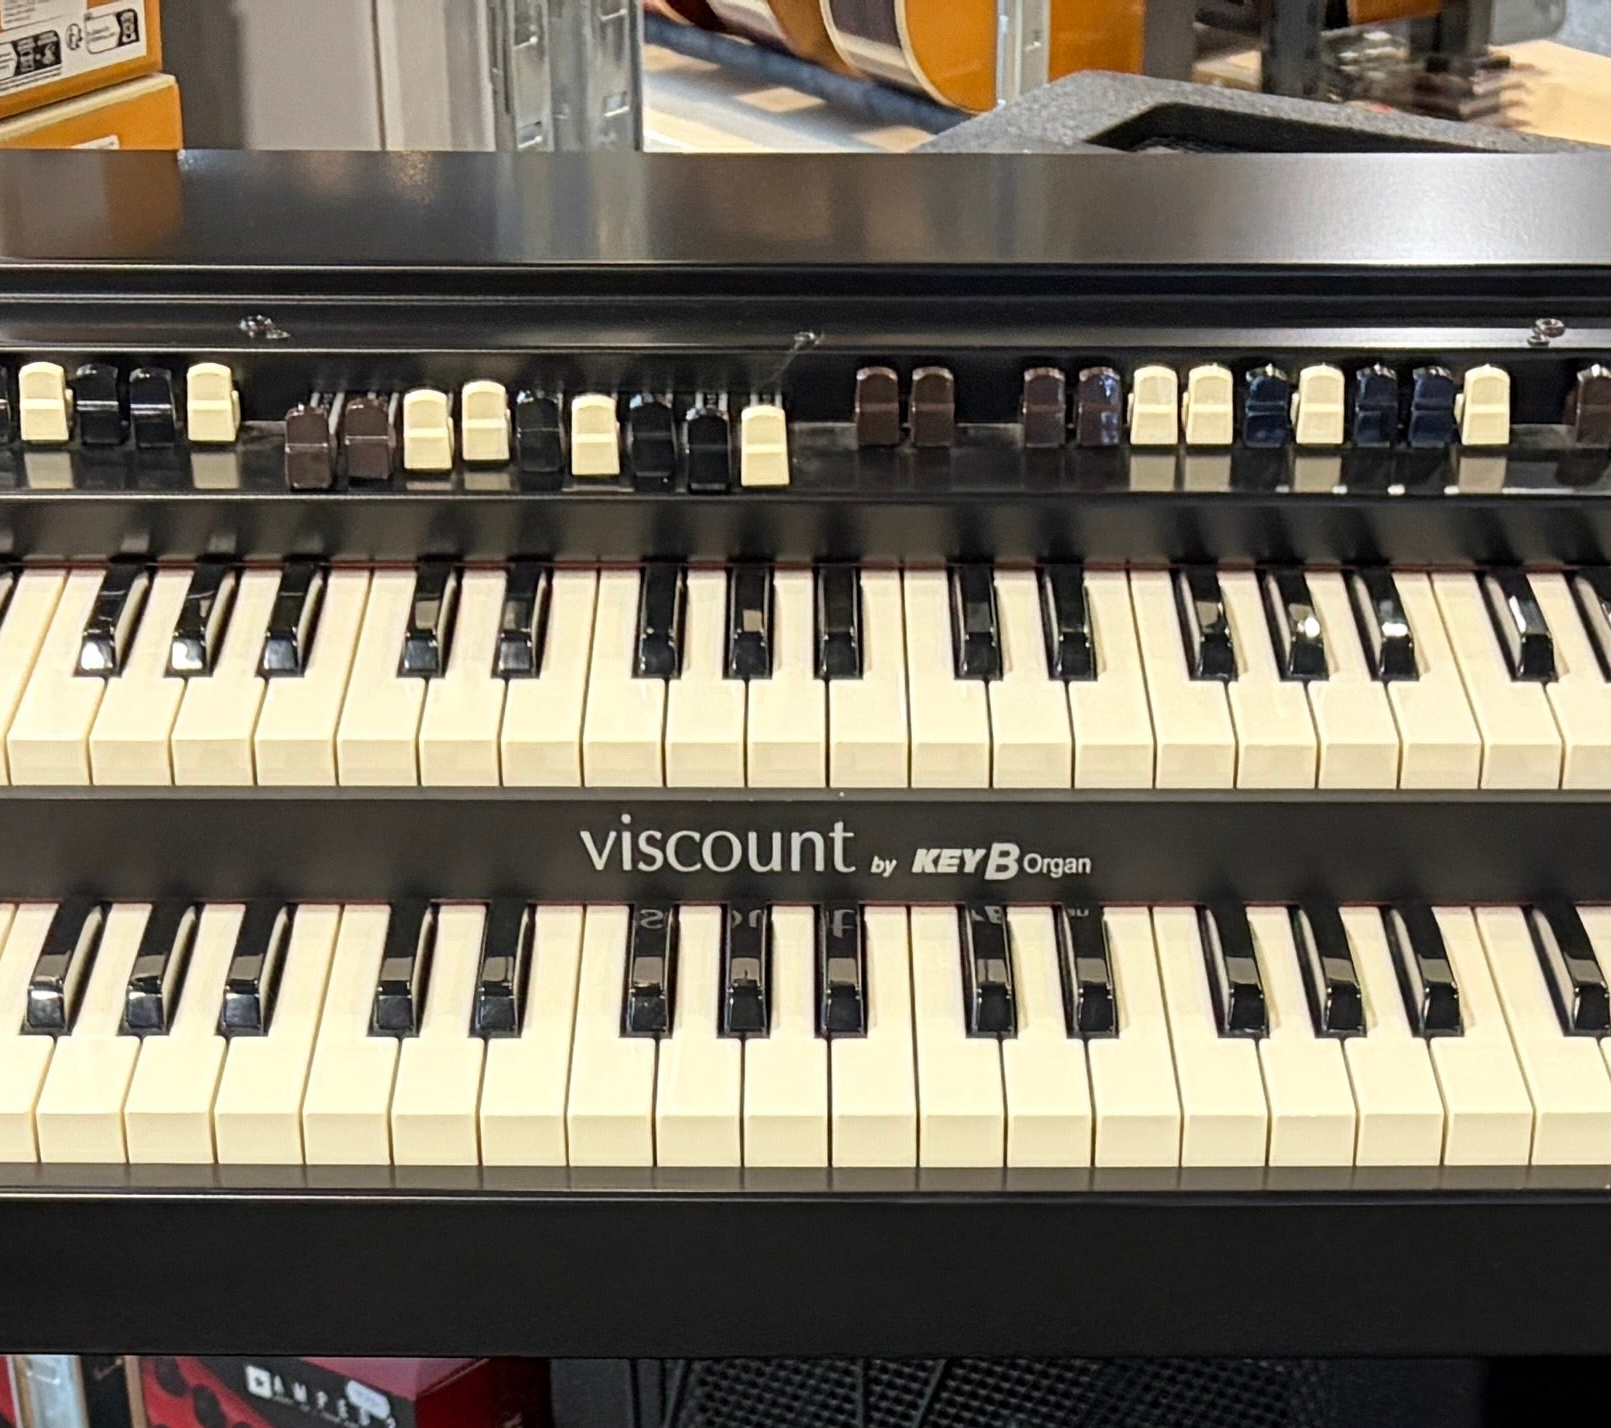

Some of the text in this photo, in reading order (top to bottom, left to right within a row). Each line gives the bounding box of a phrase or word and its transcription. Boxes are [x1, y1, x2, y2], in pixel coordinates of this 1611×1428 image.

[579, 813, 856, 874] viscount
[871, 855, 898, 878] by
[1022, 853, 1092, 879] Organ
